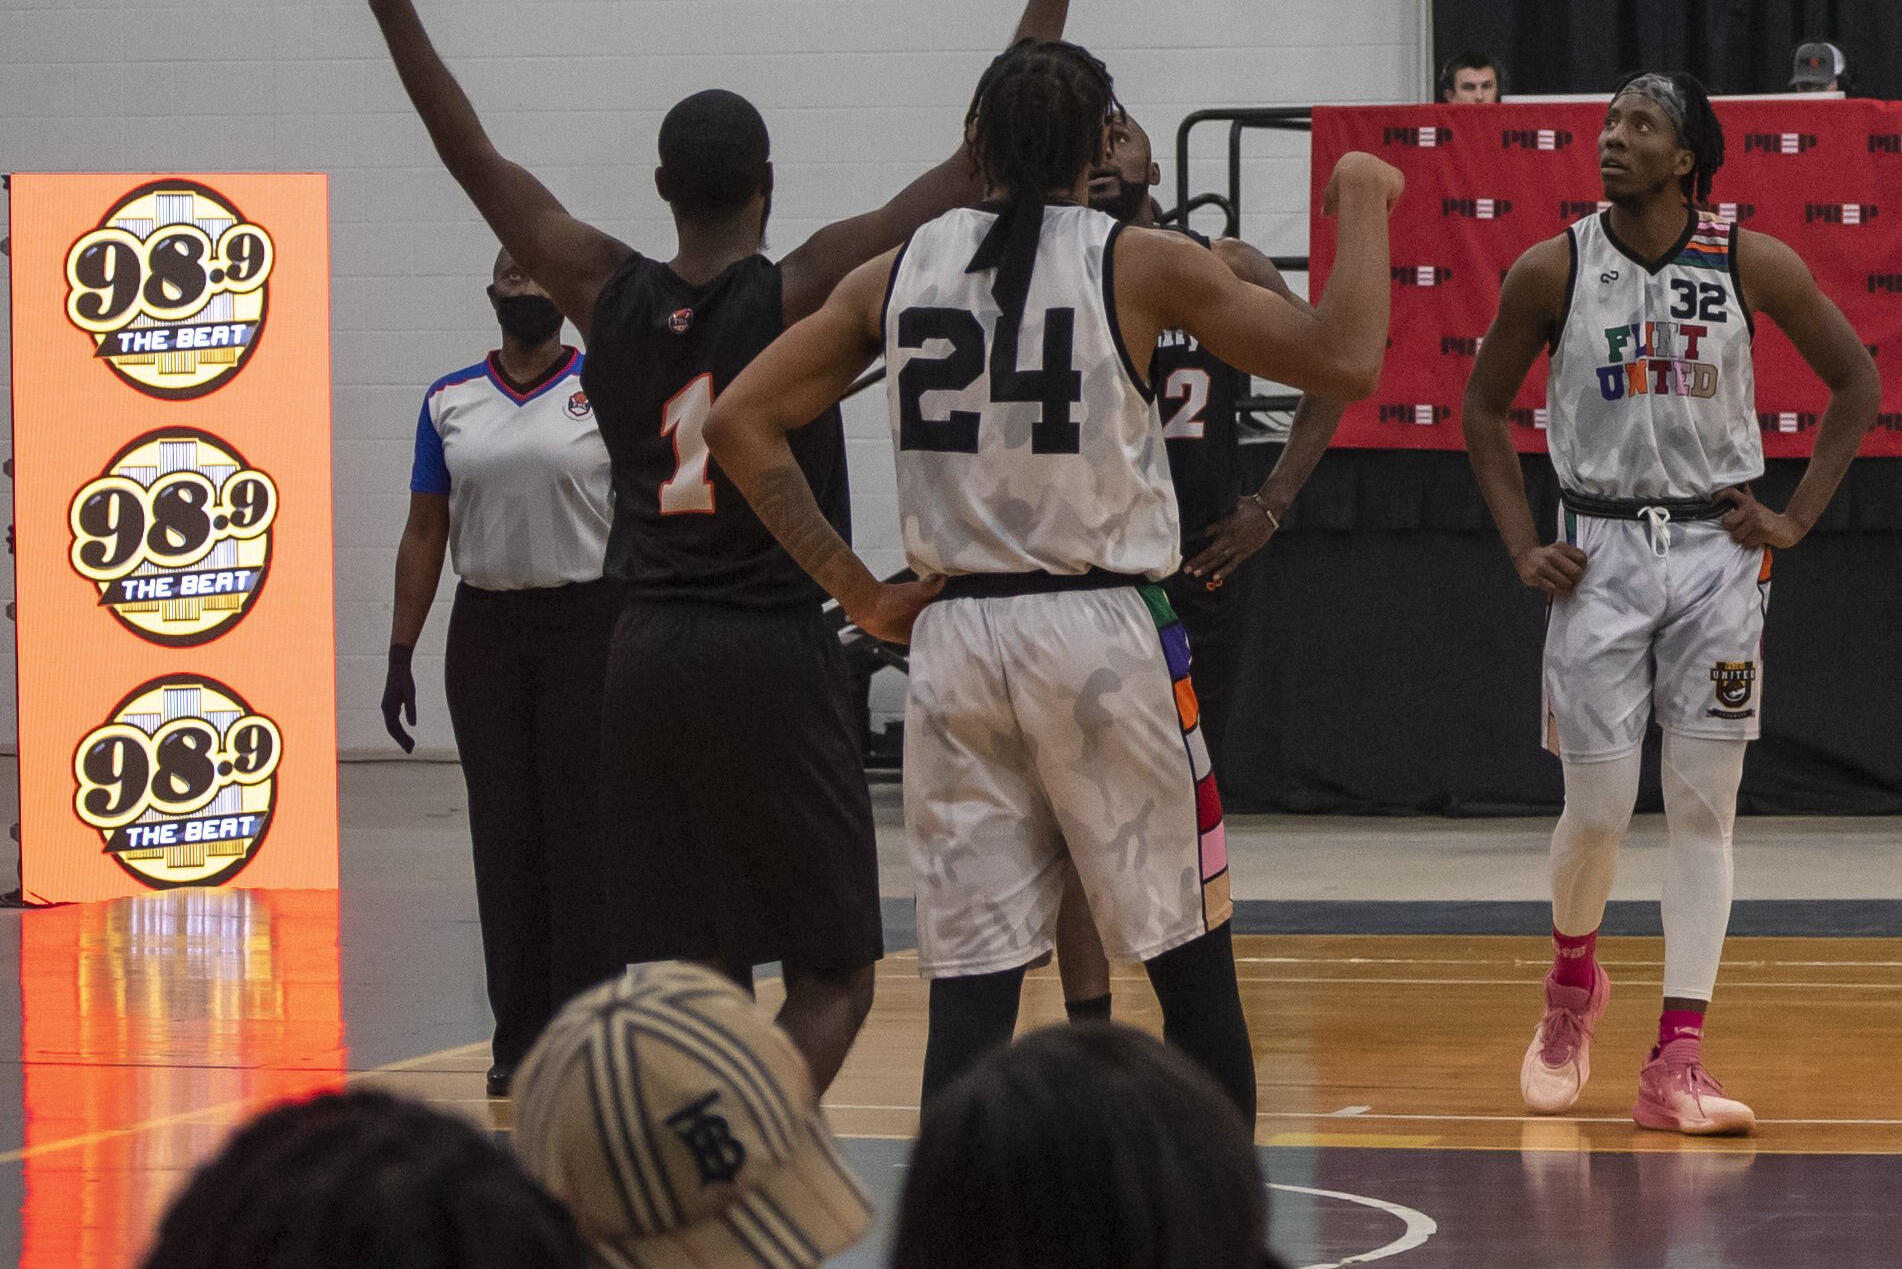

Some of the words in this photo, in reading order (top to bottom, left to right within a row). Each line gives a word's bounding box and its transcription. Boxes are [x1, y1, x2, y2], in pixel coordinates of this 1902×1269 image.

[76, 232, 265, 320] 98.9
[1670, 278, 1728, 323] 32
[117, 331, 169, 352] THE
[176, 324, 247, 348] BEAT
[1604, 321, 1708, 363] FLINT
[898, 306, 1082, 454] 24
[1596, 359, 1719, 401] UNTED
[659, 371, 716, 516] 1
[79, 478, 269, 570] 98.9
[121, 577, 174, 600] THE
[180, 570, 251, 595] BEAT
[83, 724, 273, 818] 98.9
[125, 824, 178, 847] THE
[184, 816, 255, 842] BEAT
